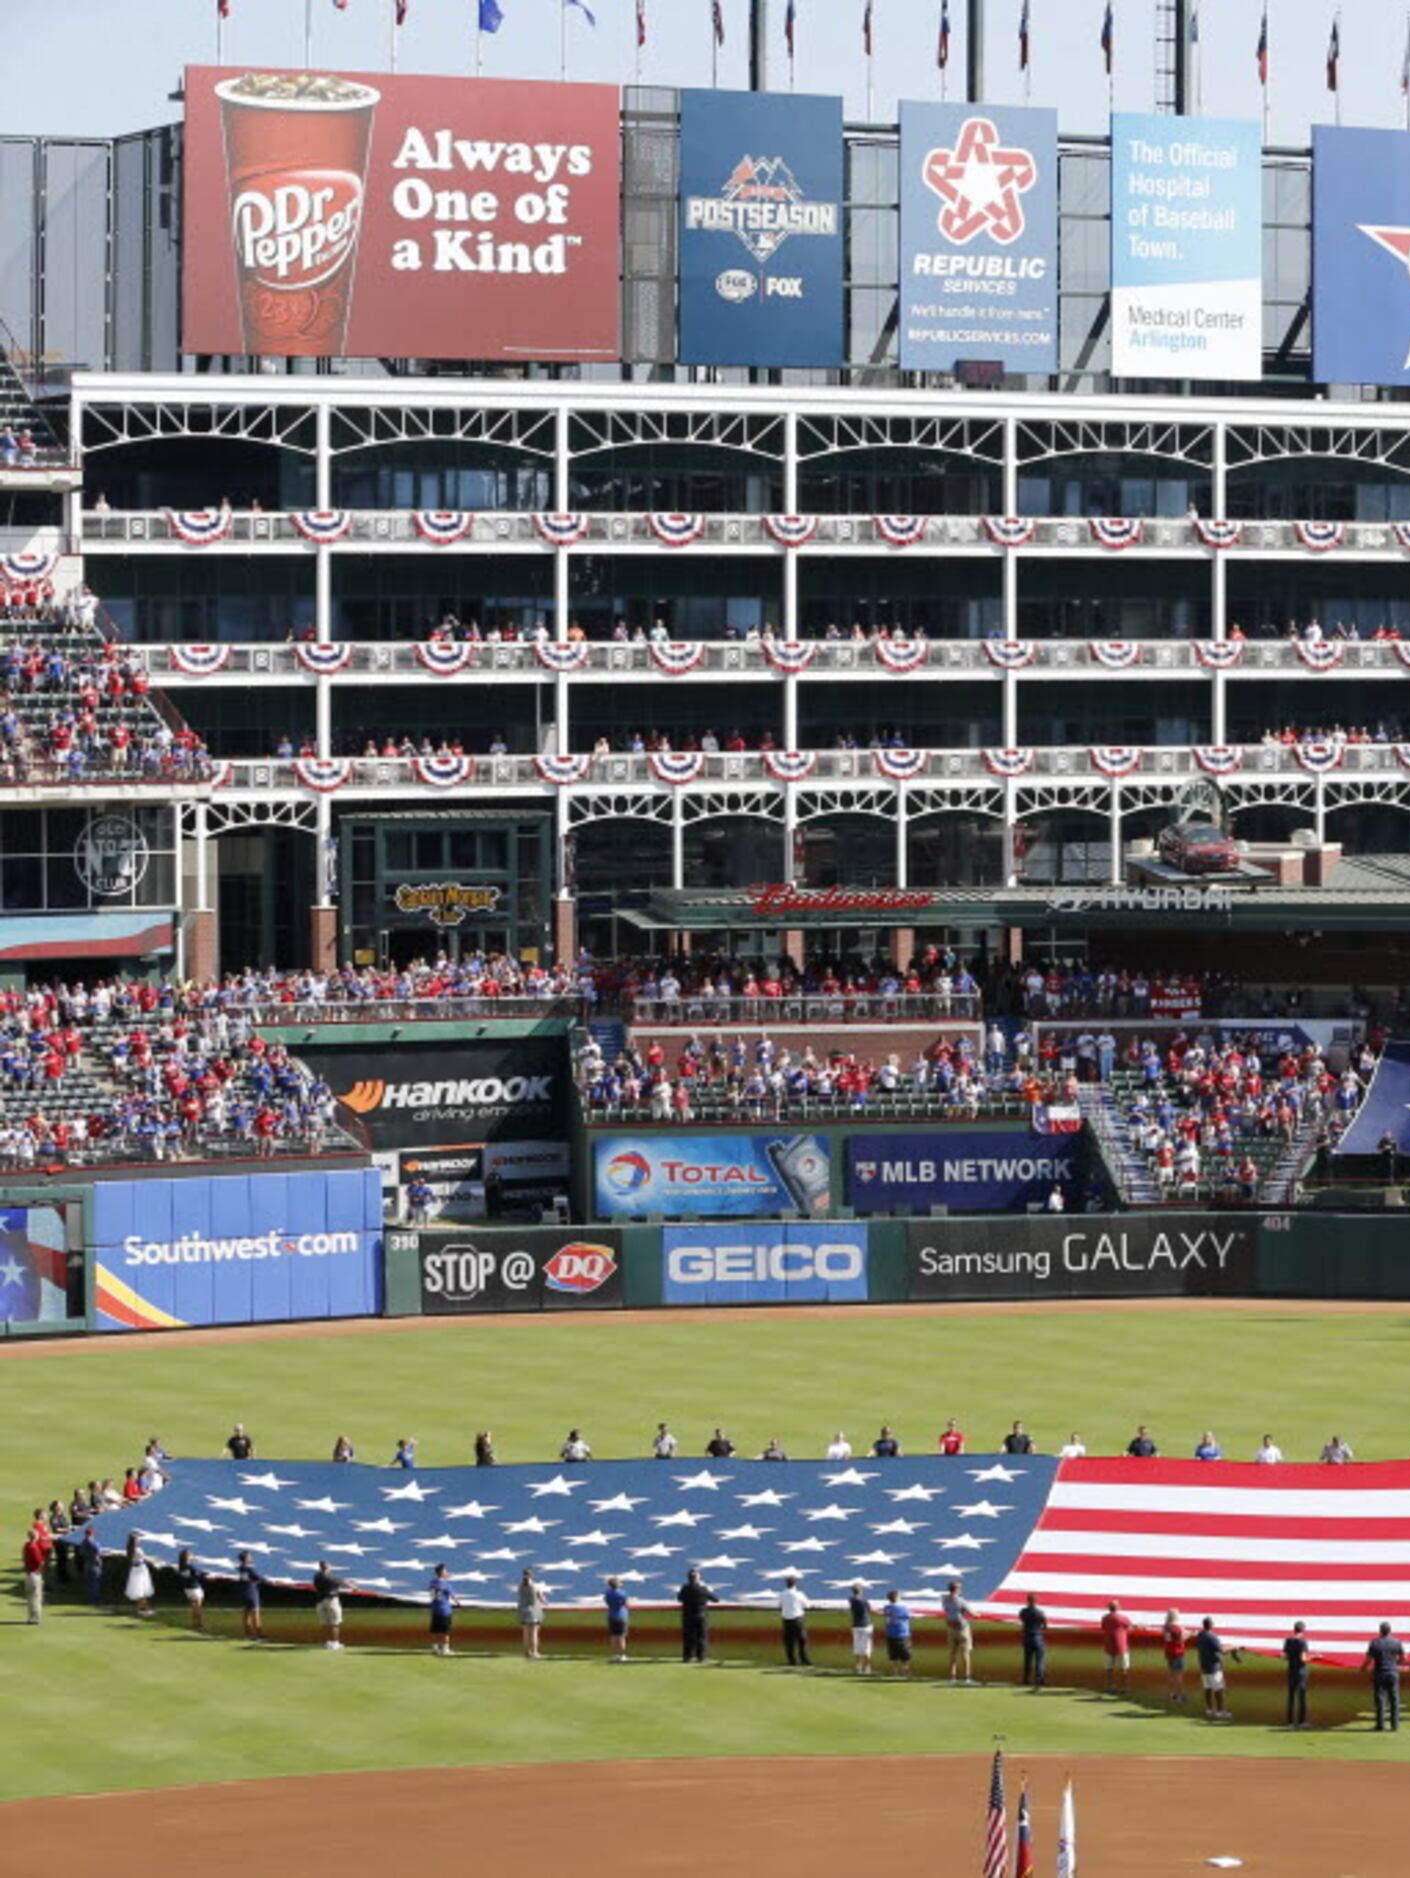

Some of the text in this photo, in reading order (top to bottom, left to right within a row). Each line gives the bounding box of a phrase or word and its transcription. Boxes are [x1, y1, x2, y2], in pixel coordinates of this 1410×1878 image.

[392, 127, 592, 182] Always
[1128, 140, 1237, 169] The Official
[1128, 173, 1209, 200] Hospital
[274, 184, 334, 234] Dr
[393, 178, 569, 223] One of
[686, 197, 838, 235] POSTSEASON
[1128, 203, 1235, 230] of Baseball
[234, 191, 361, 278] Pepper
[1128, 233, 1184, 260] Town.
[391, 239, 422, 270] a
[913, 254, 1046, 279] REPUBLIC
[767, 277, 802, 297] FOX
[942, 278, 1017, 295] SERVICES
[1128, 305, 1244, 329] Medical Center
[1128, 330, 1207, 353] Arlington
[1101, 888, 1231, 910] HYUNDAI
[413, 1106, 475, 1122] driving
[660, 1160, 768, 1184] TOTAL
[882, 1160, 936, 1183] MLB
[943, 1158, 1073, 1183] NETWORK
[1263, 1215, 1291, 1231] 404
[668, 1244, 864, 1283] GEICO
[919, 1232, 1238, 1279] Samsung GALAXY
[424, 1252, 605, 1293] STOP @ DQ
